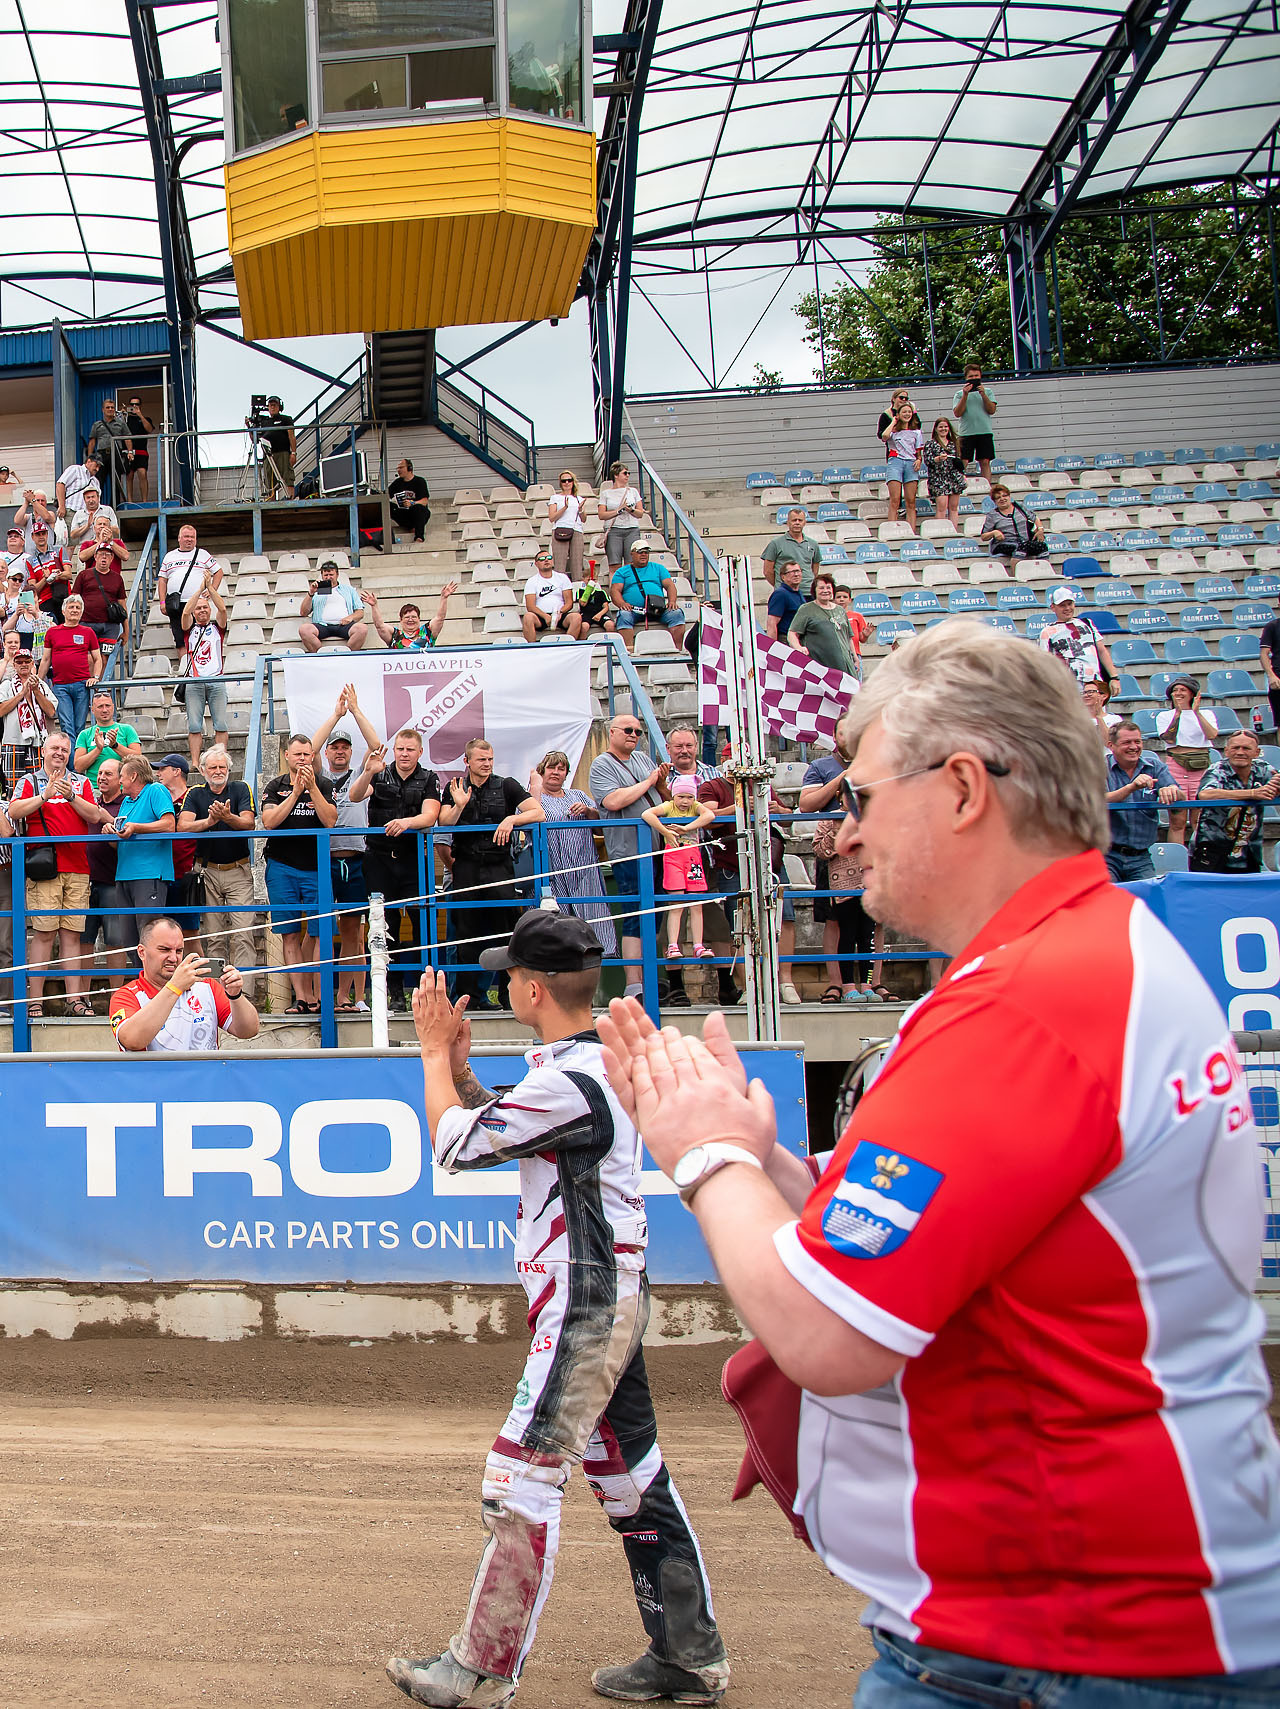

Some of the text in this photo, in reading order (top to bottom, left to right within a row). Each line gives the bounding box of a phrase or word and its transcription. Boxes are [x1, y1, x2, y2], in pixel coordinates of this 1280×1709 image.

[383, 659, 483, 672] DAUGAVPILS
[203, 1220, 518, 1249] CAR PARTS ONLIN
